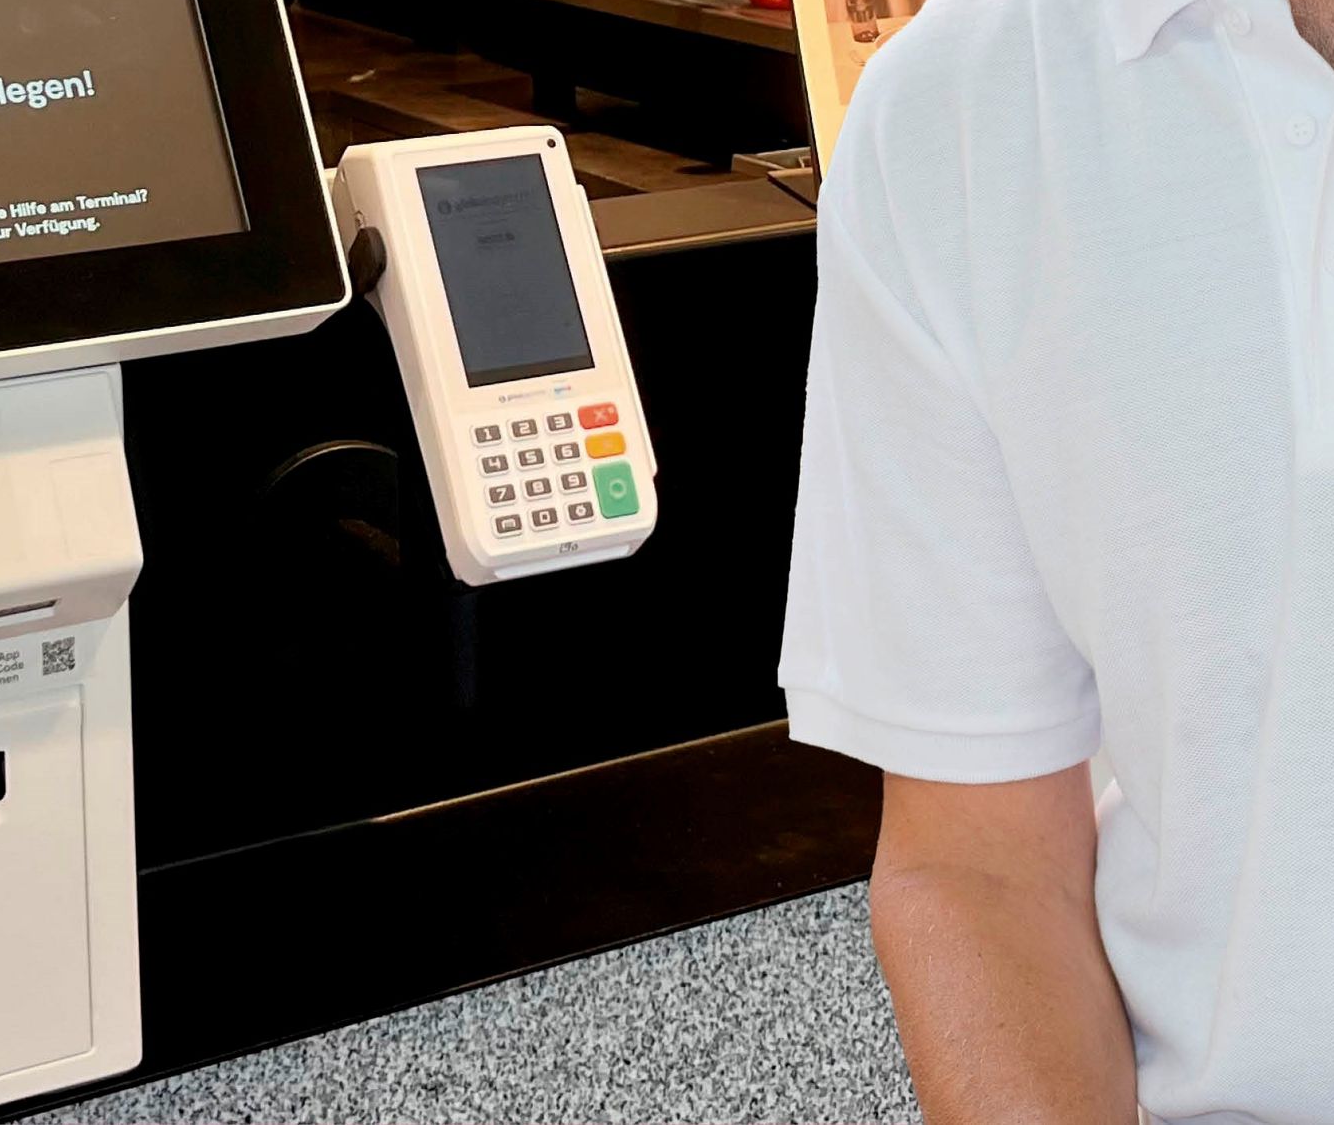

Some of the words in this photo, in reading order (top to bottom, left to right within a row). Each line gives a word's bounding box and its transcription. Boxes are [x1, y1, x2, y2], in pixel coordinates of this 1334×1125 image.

[9, 202, 47, 219] Hilfe
[49, 200, 75, 213] am
[76, 188, 149, 210] Terminal?
[14, 217, 101, 238] Verfügung.
